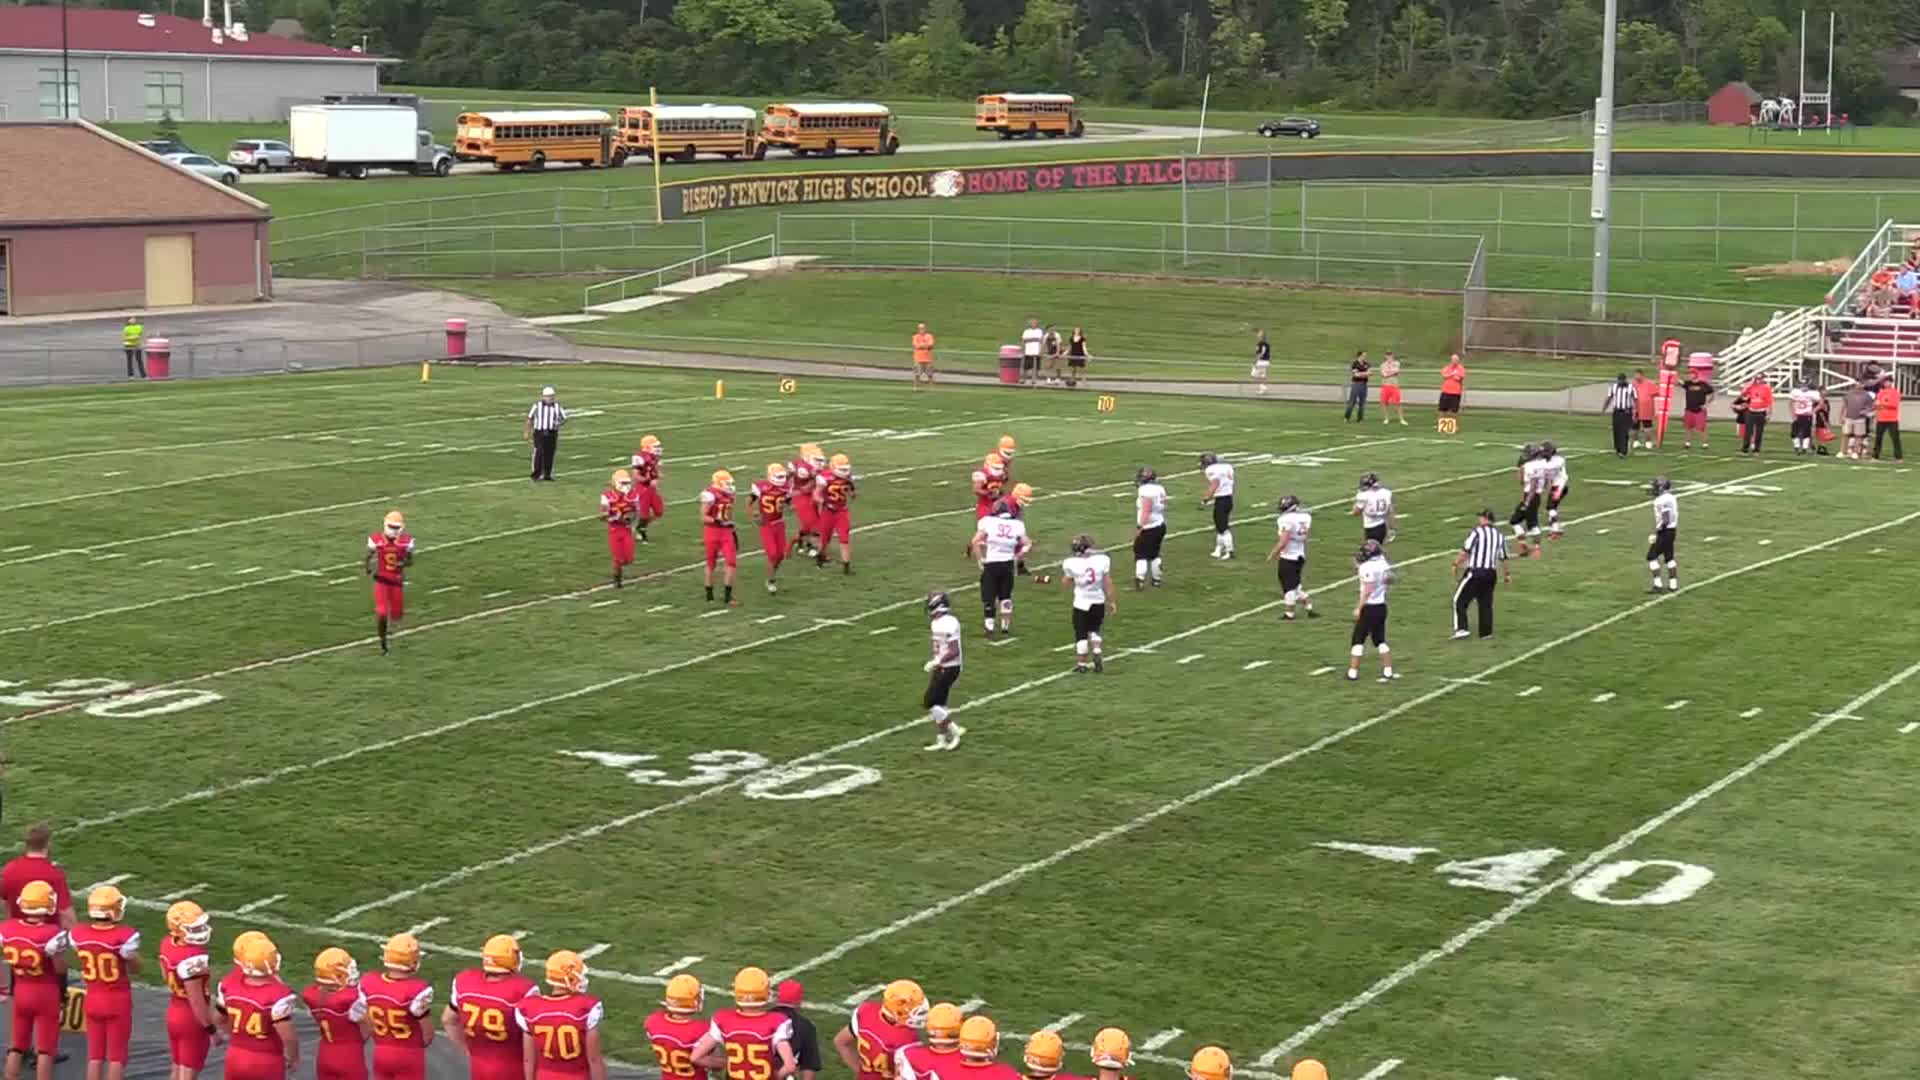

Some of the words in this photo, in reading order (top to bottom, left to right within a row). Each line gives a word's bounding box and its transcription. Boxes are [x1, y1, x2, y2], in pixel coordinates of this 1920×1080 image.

[967, 169, 1028, 193] HOME
[1035, 167, 1065, 188] OF
[1072, 164, 1117, 186] THE
[1125, 160, 1236, 184] FALCONS
[682, 187, 726, 213] BISHOP
[730, 179, 800, 208] FENWICK
[803, 177, 846, 201] HIGH
[851, 175, 928, 200] SCHOOL
[1440, 419, 1455, 433] 20
[997, 523, 1013, 540] 92
[1084, 567, 1097, 586] 3
[78, 950, 119, 982] 30
[228, 1006, 268, 1039] 74
[367, 1005, 412, 1040] 65
[462, 1003, 508, 1041] 79
[534, 1024, 582, 1060] 70
[725, 1041, 771, 1080] 25
